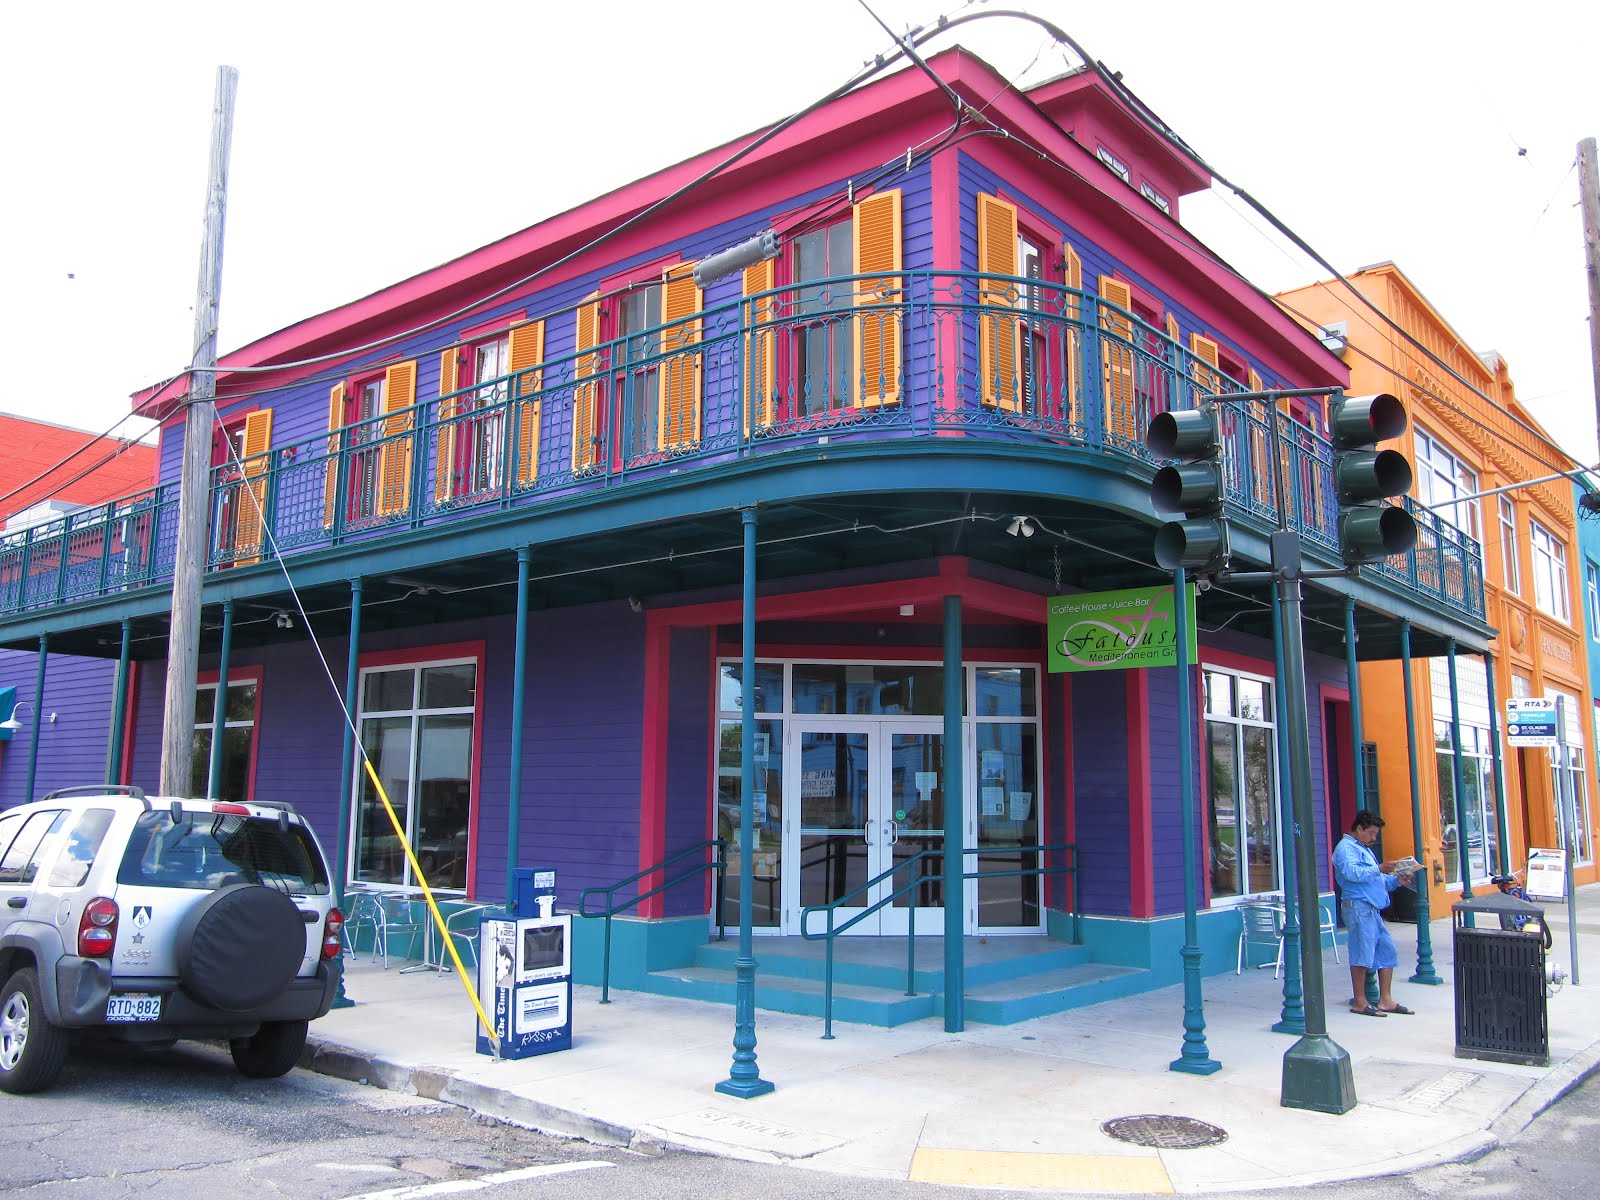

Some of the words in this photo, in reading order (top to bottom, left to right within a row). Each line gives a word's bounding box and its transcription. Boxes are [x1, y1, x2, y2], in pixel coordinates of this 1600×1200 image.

[1051, 605, 1080, 614] Coffee
[1081, 603, 1107, 611] House
[1111, 600, 1134, 609] Juice
[1135, 598, 1150, 607] Bar
[1089, 649, 1159, 662] Mediterranean
[123, 948, 152, 959] Jeep
[497, 987, 506, 1015] Time
[497, 1017, 506, 1038] The
